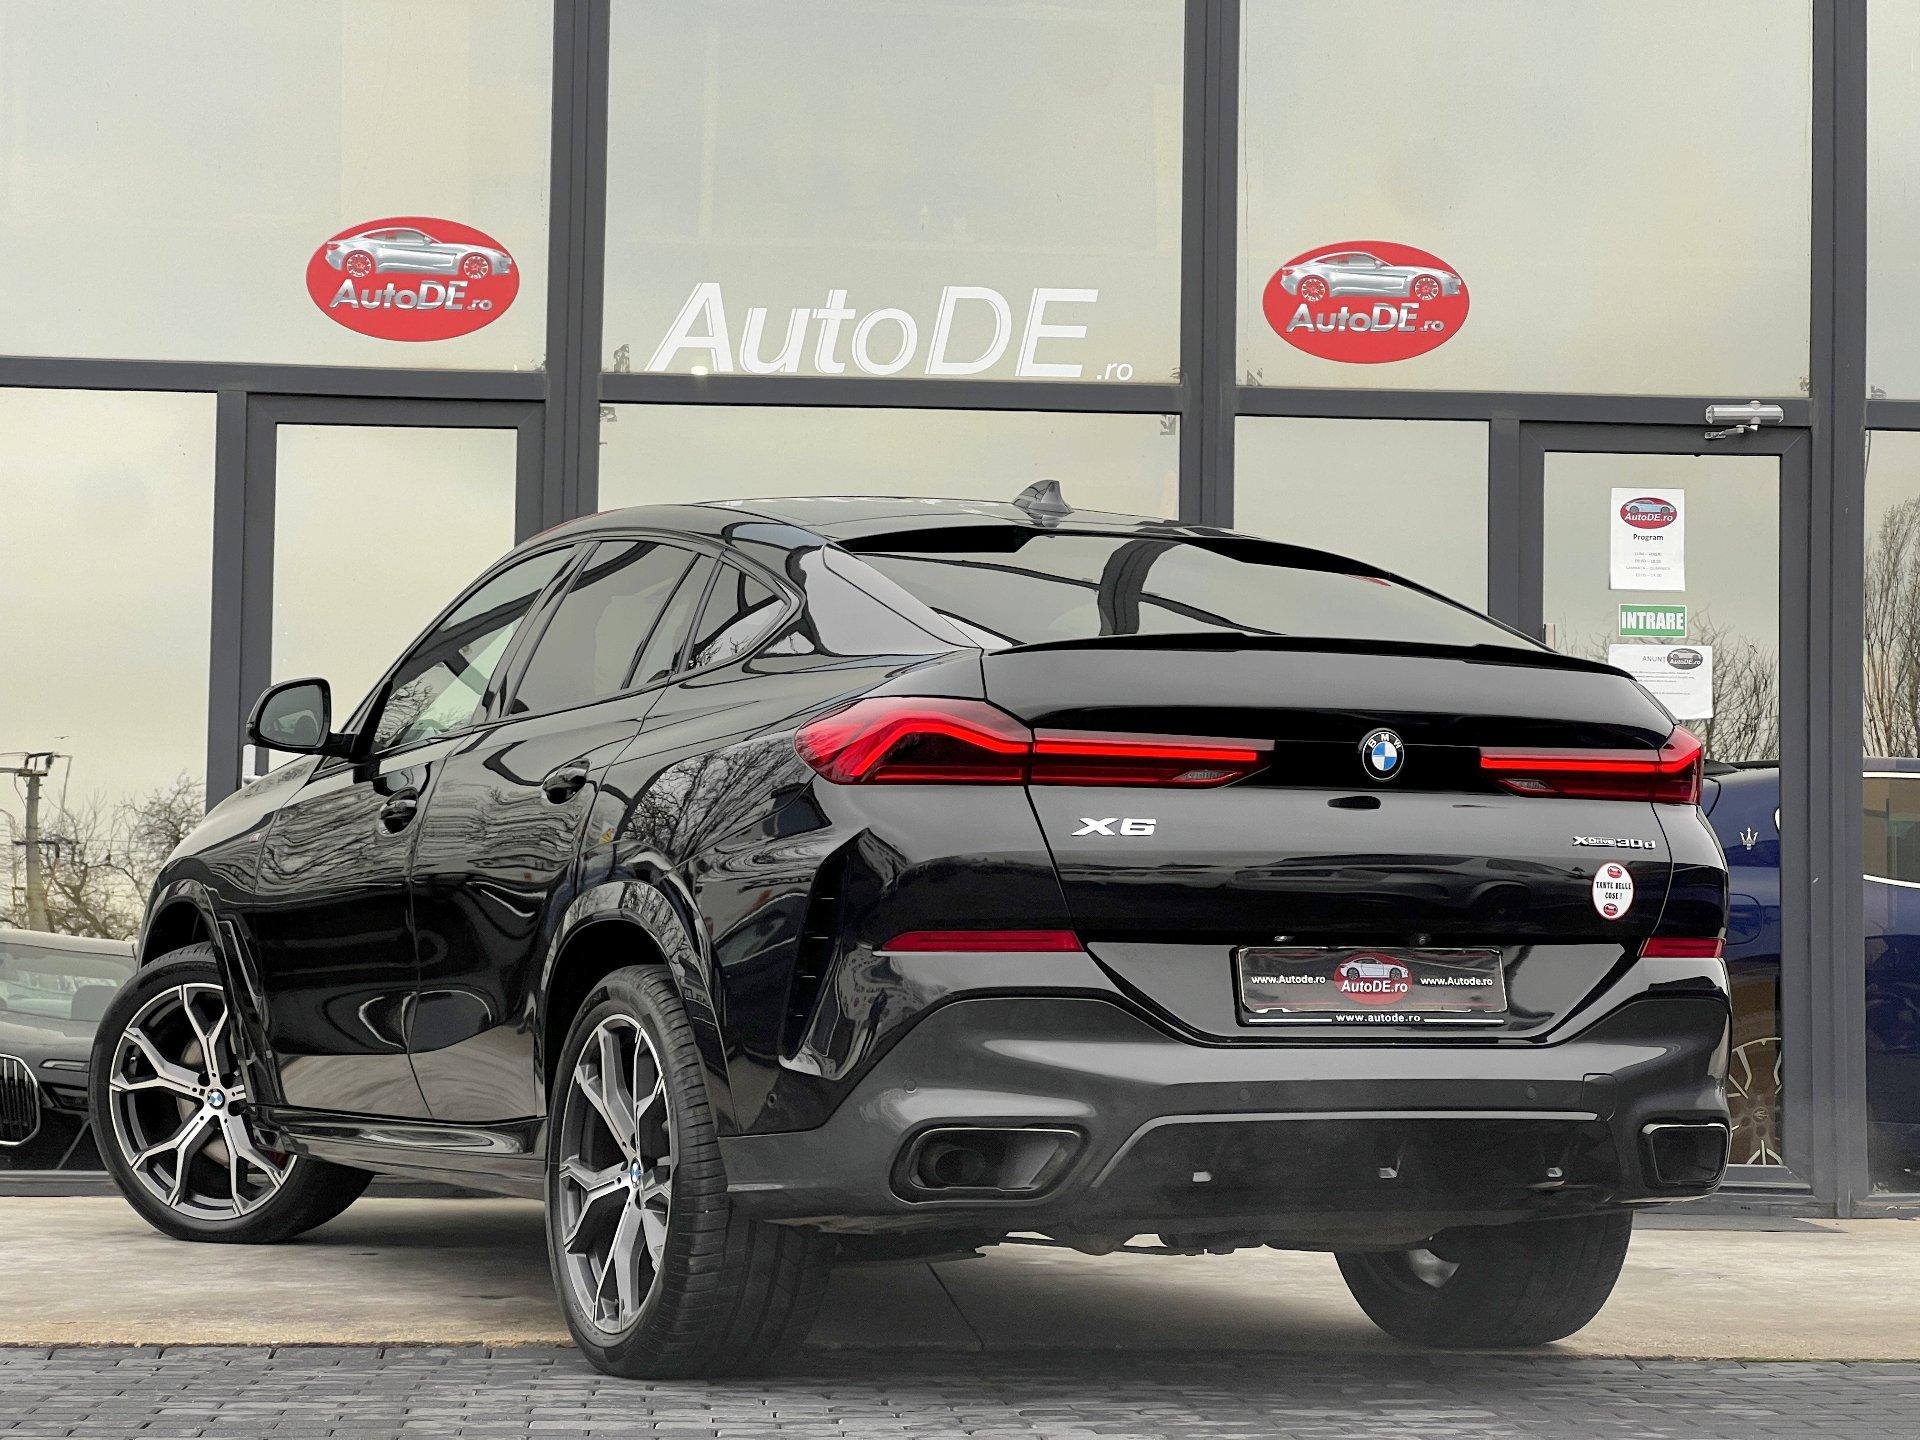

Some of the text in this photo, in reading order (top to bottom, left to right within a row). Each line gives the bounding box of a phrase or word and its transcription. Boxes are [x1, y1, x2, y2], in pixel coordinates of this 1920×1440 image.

[1624, 512, 1673, 522] AutoDE.ro
[1621, 611, 1684, 630] INTRARE
[1367, 733, 1403, 749] BMW
[1071, 817, 1157, 836] X6
[1251, 974, 1326, 985] www.Autode.ro
[1420, 976, 1493, 986] www.Autode.ro
[1341, 980, 1408, 993] AutoDE.ro
[1336, 1013, 1421, 1023] www.autode.ro
